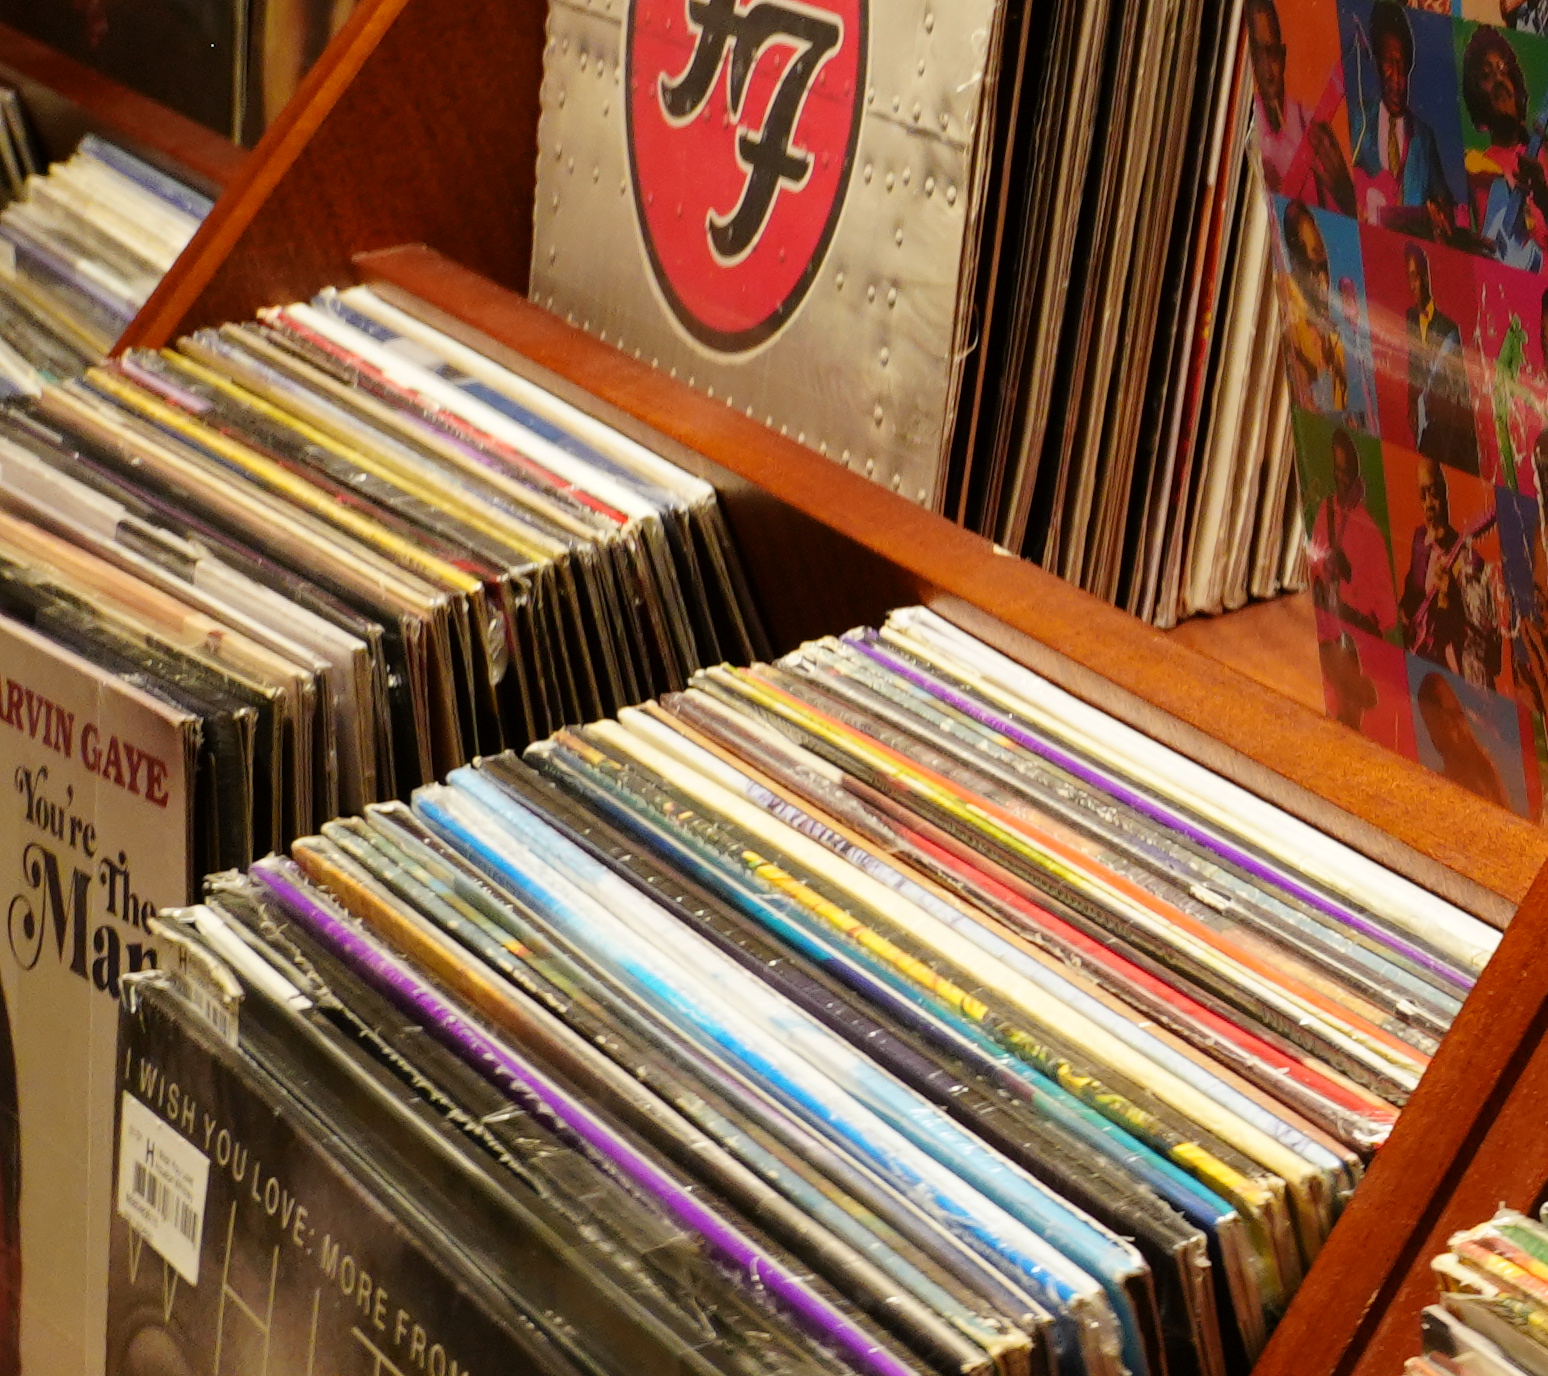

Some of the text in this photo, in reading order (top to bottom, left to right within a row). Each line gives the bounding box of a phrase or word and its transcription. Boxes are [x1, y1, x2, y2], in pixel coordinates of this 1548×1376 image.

[0, 678, 170, 809] RVIN GAYE
[15, 764, 98, 859] You're
[100, 848, 158, 937] The
[124, 1047, 133, 1079] I
[138, 1057, 197, 1134] WISH
[203, 1113, 249, 1183] YOU
[251, 1160, 317, 1256] LOVE:
[319, 1233, 389, 1333] MORE
[145, 1137, 156, 1168] H
